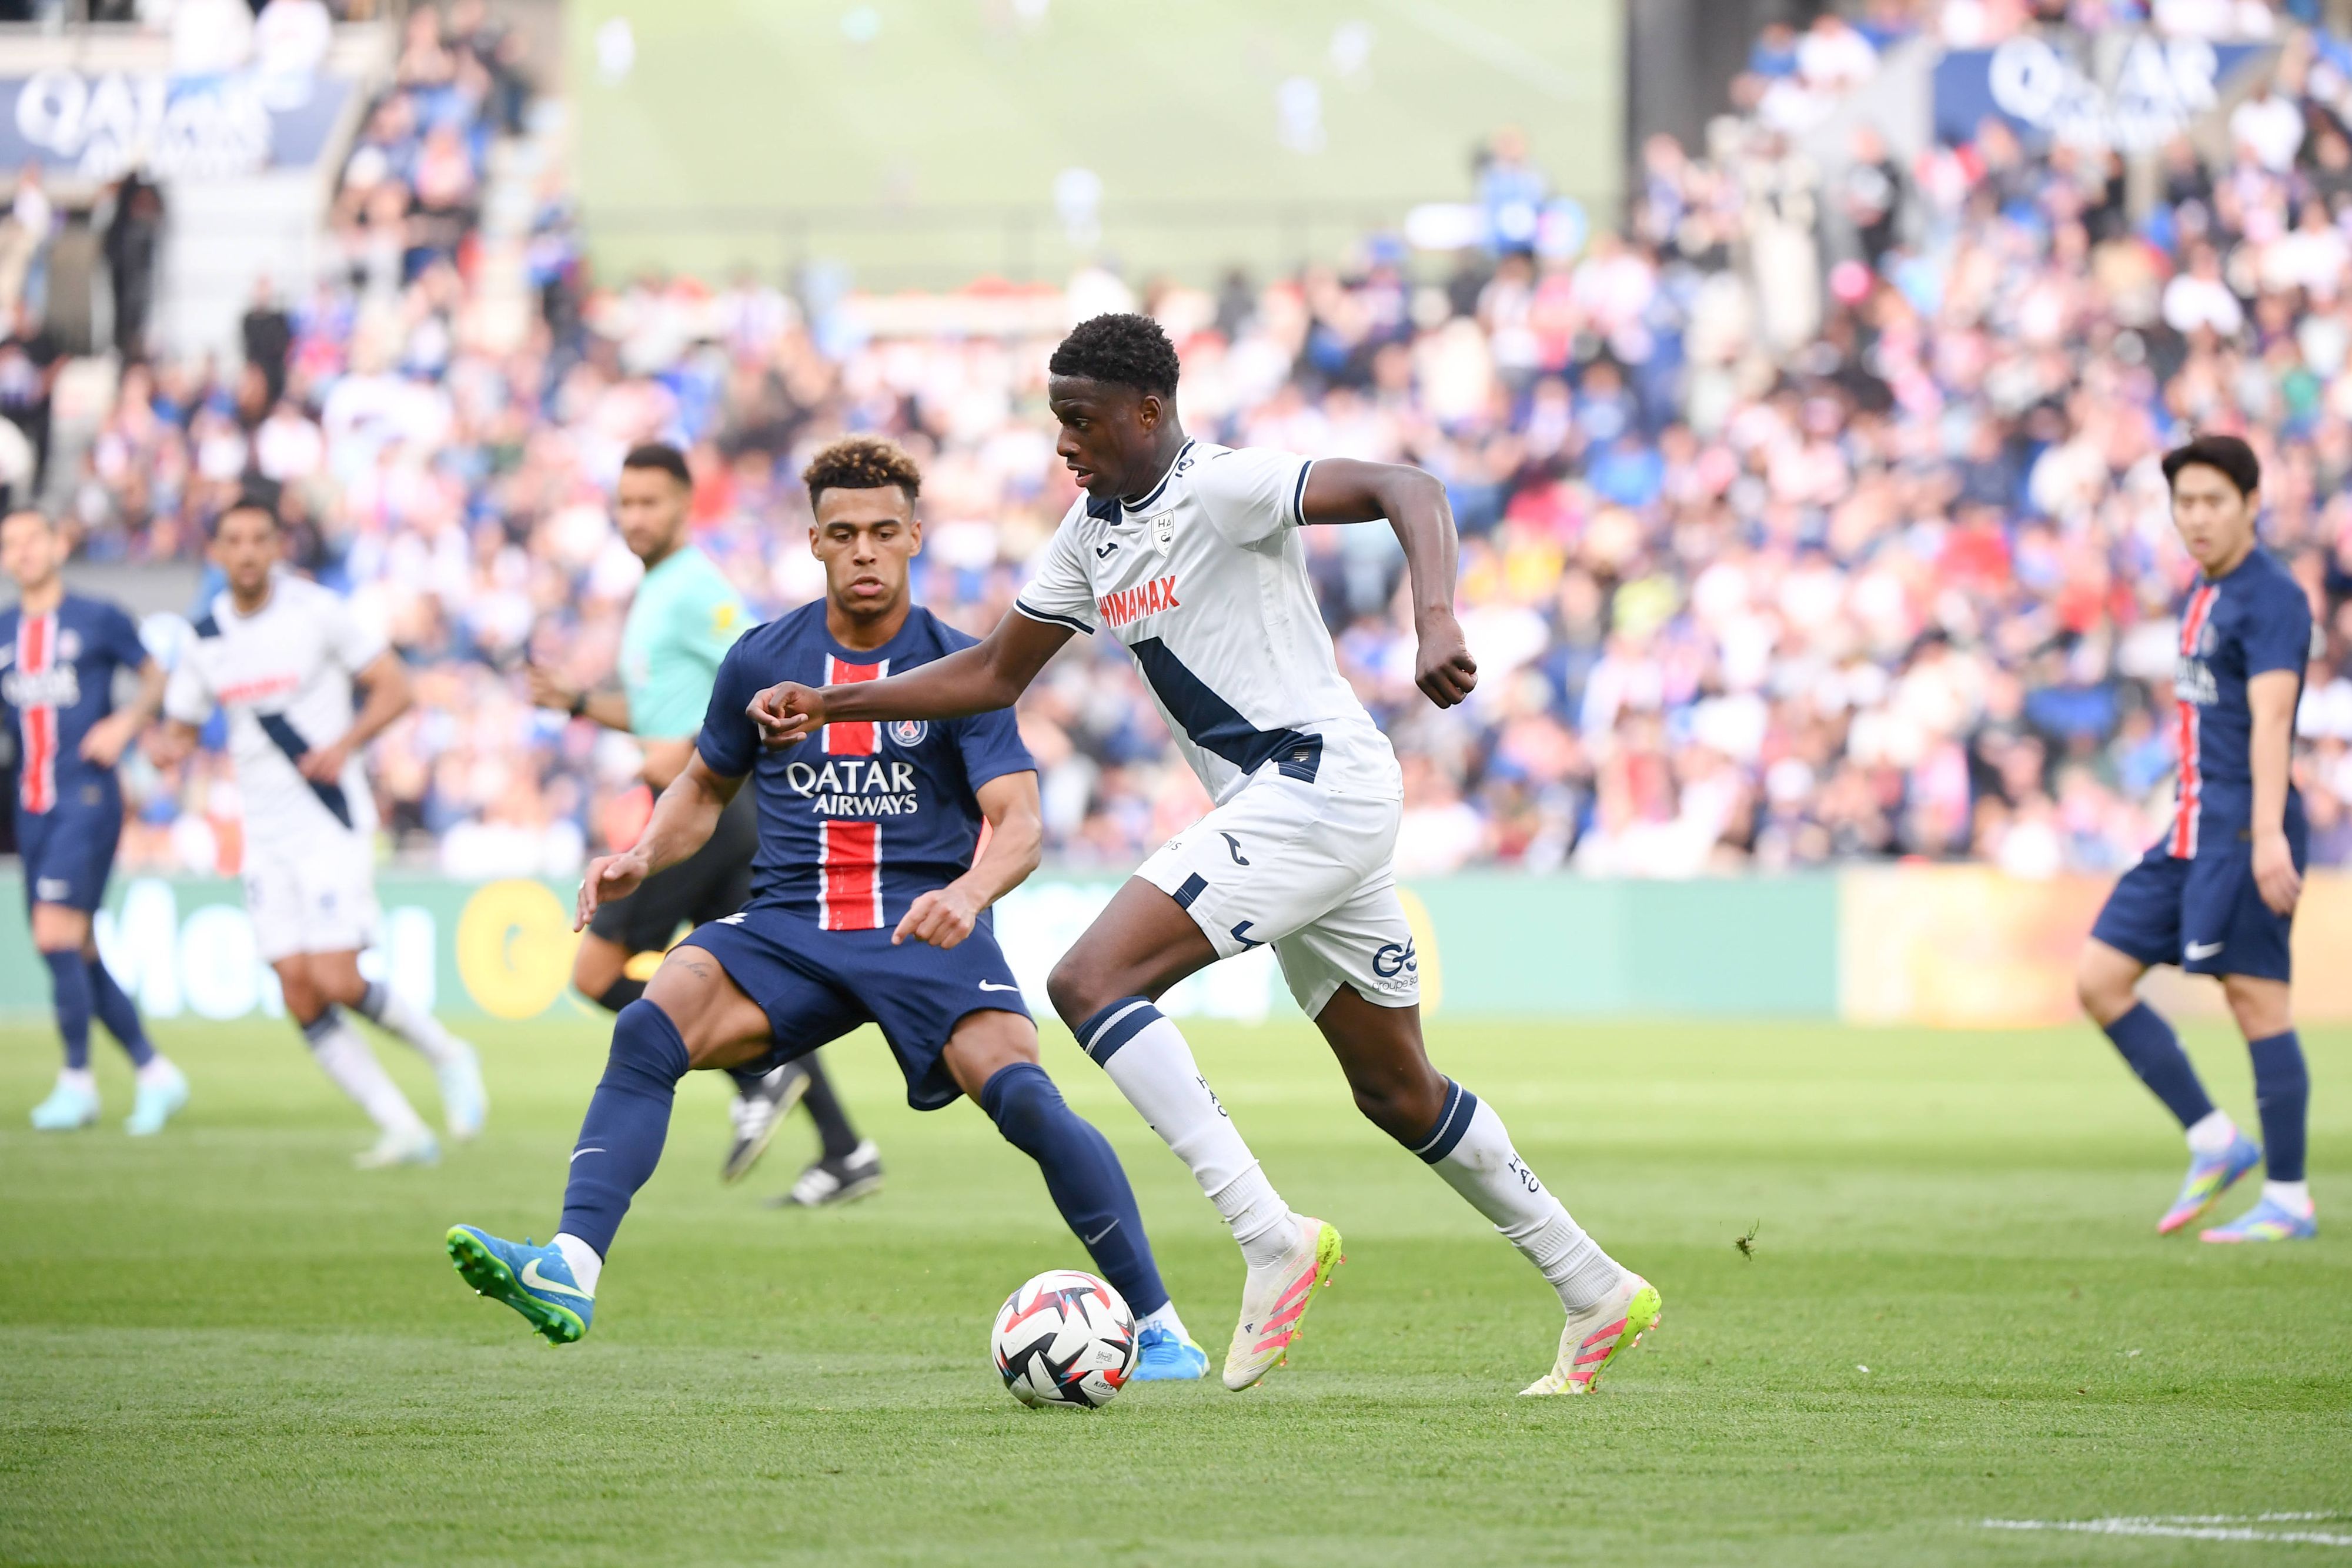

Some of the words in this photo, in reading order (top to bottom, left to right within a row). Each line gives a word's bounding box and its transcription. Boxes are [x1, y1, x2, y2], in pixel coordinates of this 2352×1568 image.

[786, 760, 917, 799] QATAR
[812, 793, 918, 816] AIRWAYS
[1372, 979, 1408, 992] groupe
